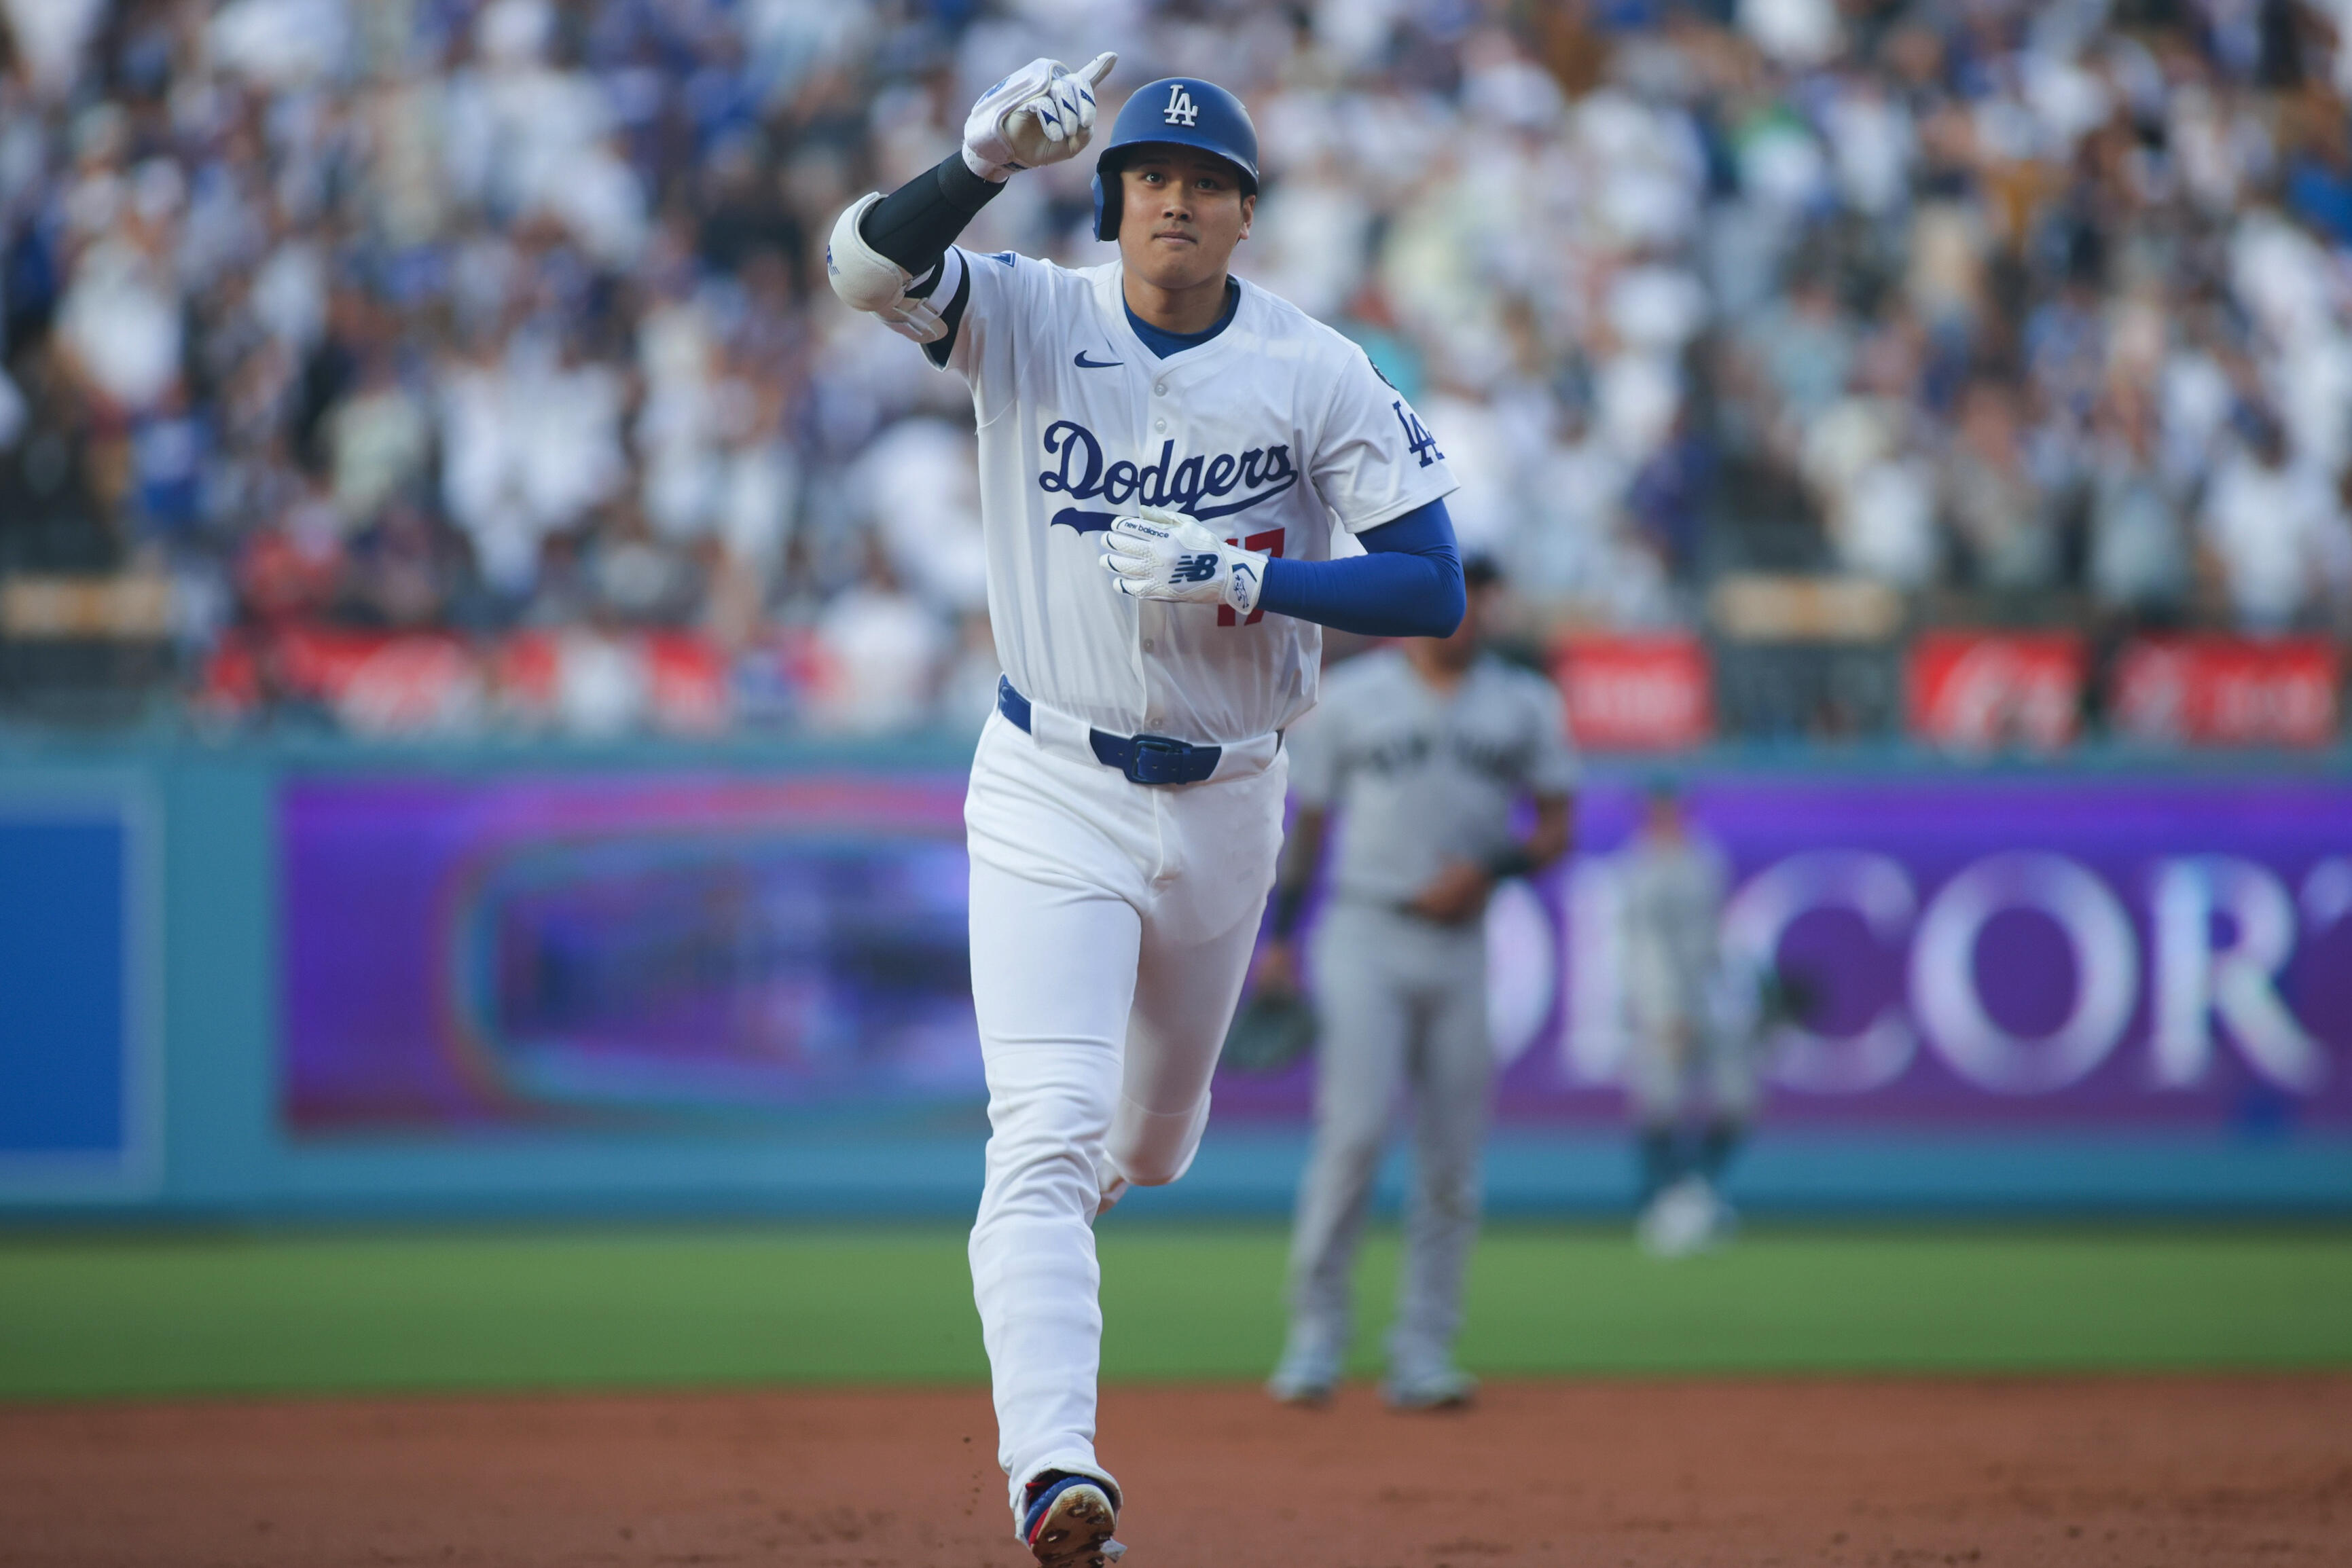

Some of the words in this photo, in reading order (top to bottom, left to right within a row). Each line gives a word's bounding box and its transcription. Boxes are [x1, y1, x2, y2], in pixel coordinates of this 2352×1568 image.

[1163, 84, 1199, 127] LA
[1392, 400, 1445, 469] LA
[1038, 420, 1299, 522] Dodgers
[1138, 524, 1170, 538] balance
